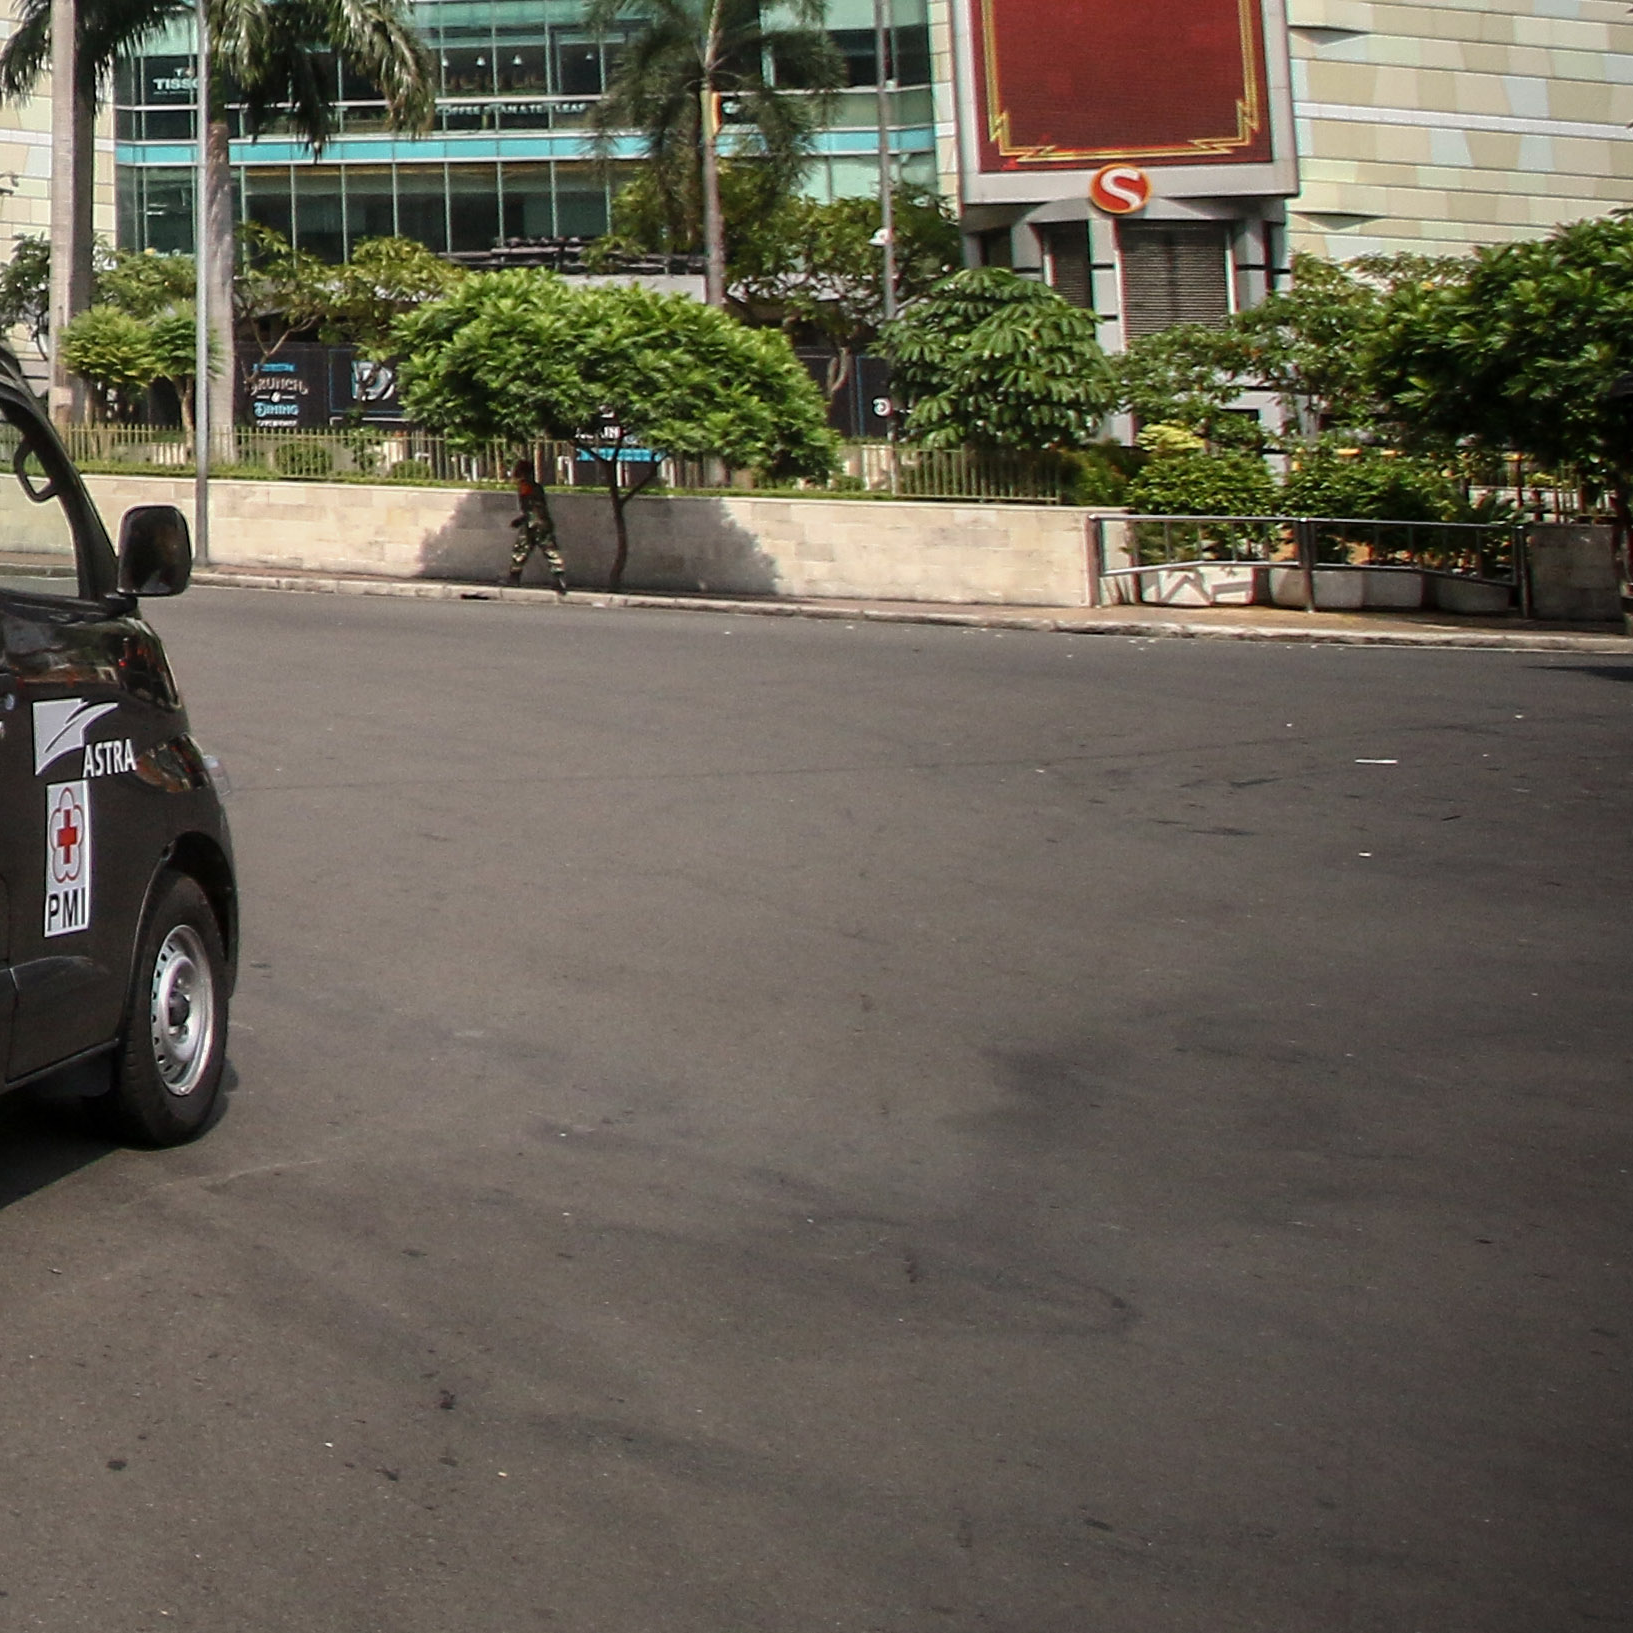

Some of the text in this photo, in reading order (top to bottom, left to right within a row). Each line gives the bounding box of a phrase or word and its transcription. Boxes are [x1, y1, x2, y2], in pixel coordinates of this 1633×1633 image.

[152, 77, 200, 90] TISSO
[247, 377, 309, 397] RUNCH
[82, 738, 137, 779] ASTRA
[46, 886, 86, 932] PMI
